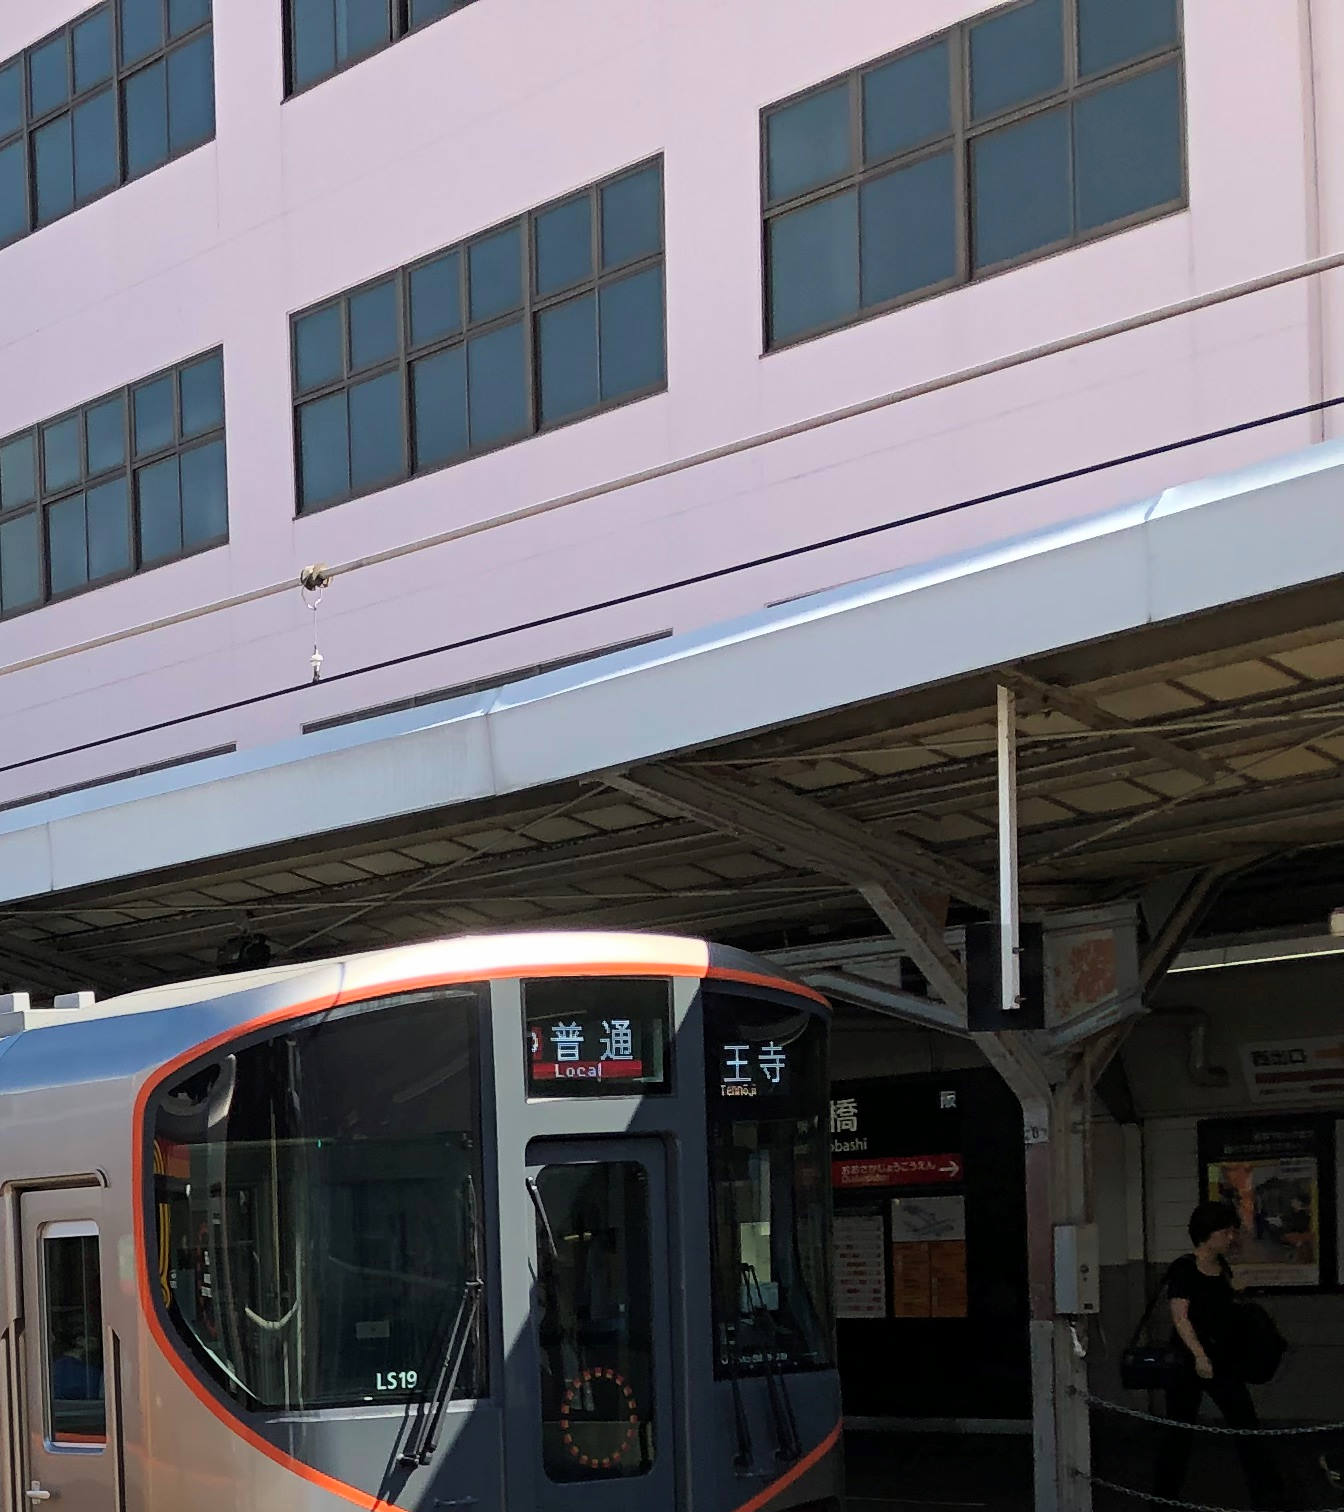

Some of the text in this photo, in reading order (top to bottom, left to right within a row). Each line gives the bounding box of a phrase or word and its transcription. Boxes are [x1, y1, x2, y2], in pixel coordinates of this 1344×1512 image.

[550, 1019, 634, 1062] 普通
[554, 1062, 603, 1079] Local
[723, 1040, 787, 1083] 王寺
[376, 1370, 419, 1390] LS19
